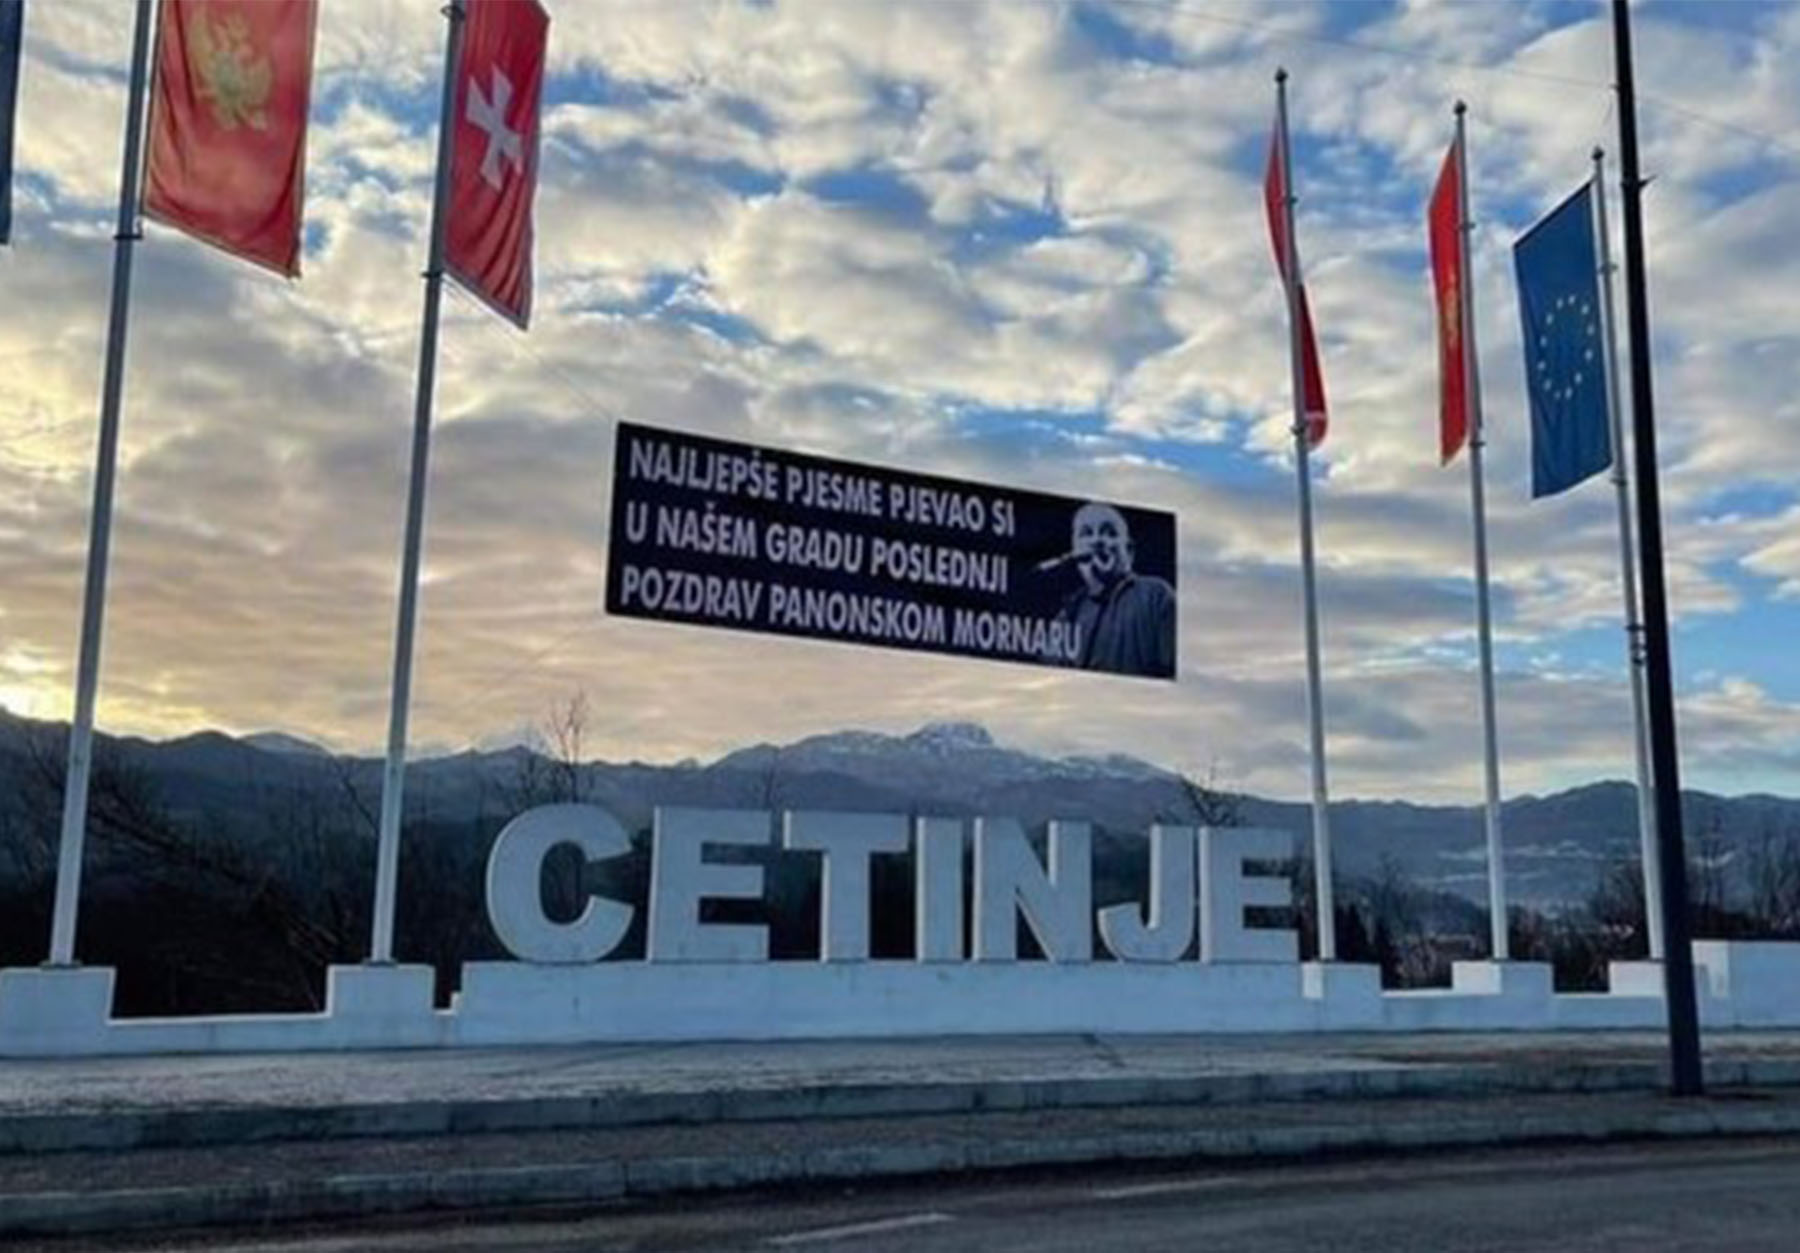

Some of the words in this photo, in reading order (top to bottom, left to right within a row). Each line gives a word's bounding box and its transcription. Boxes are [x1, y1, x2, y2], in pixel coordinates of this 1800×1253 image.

[629, 438, 778, 499] NAJLJEPŠE
[786, 466, 882, 517] PJESME
[889, 484, 985, 532] PJEVAO
[991, 499, 1015, 537] SI
[625, 501, 648, 544] U
[656, 501, 758, 559] NAŠEM
[765, 523, 863, 573] GRADU
[870, 537, 1008, 594] POSLEDNJI
[620, 564, 762, 621] POZDRAV
[768, 584, 946, 643] PANONSKOM
[952, 609, 1082, 659] MORNARU
[484, 803, 1300, 963] CETINJE
